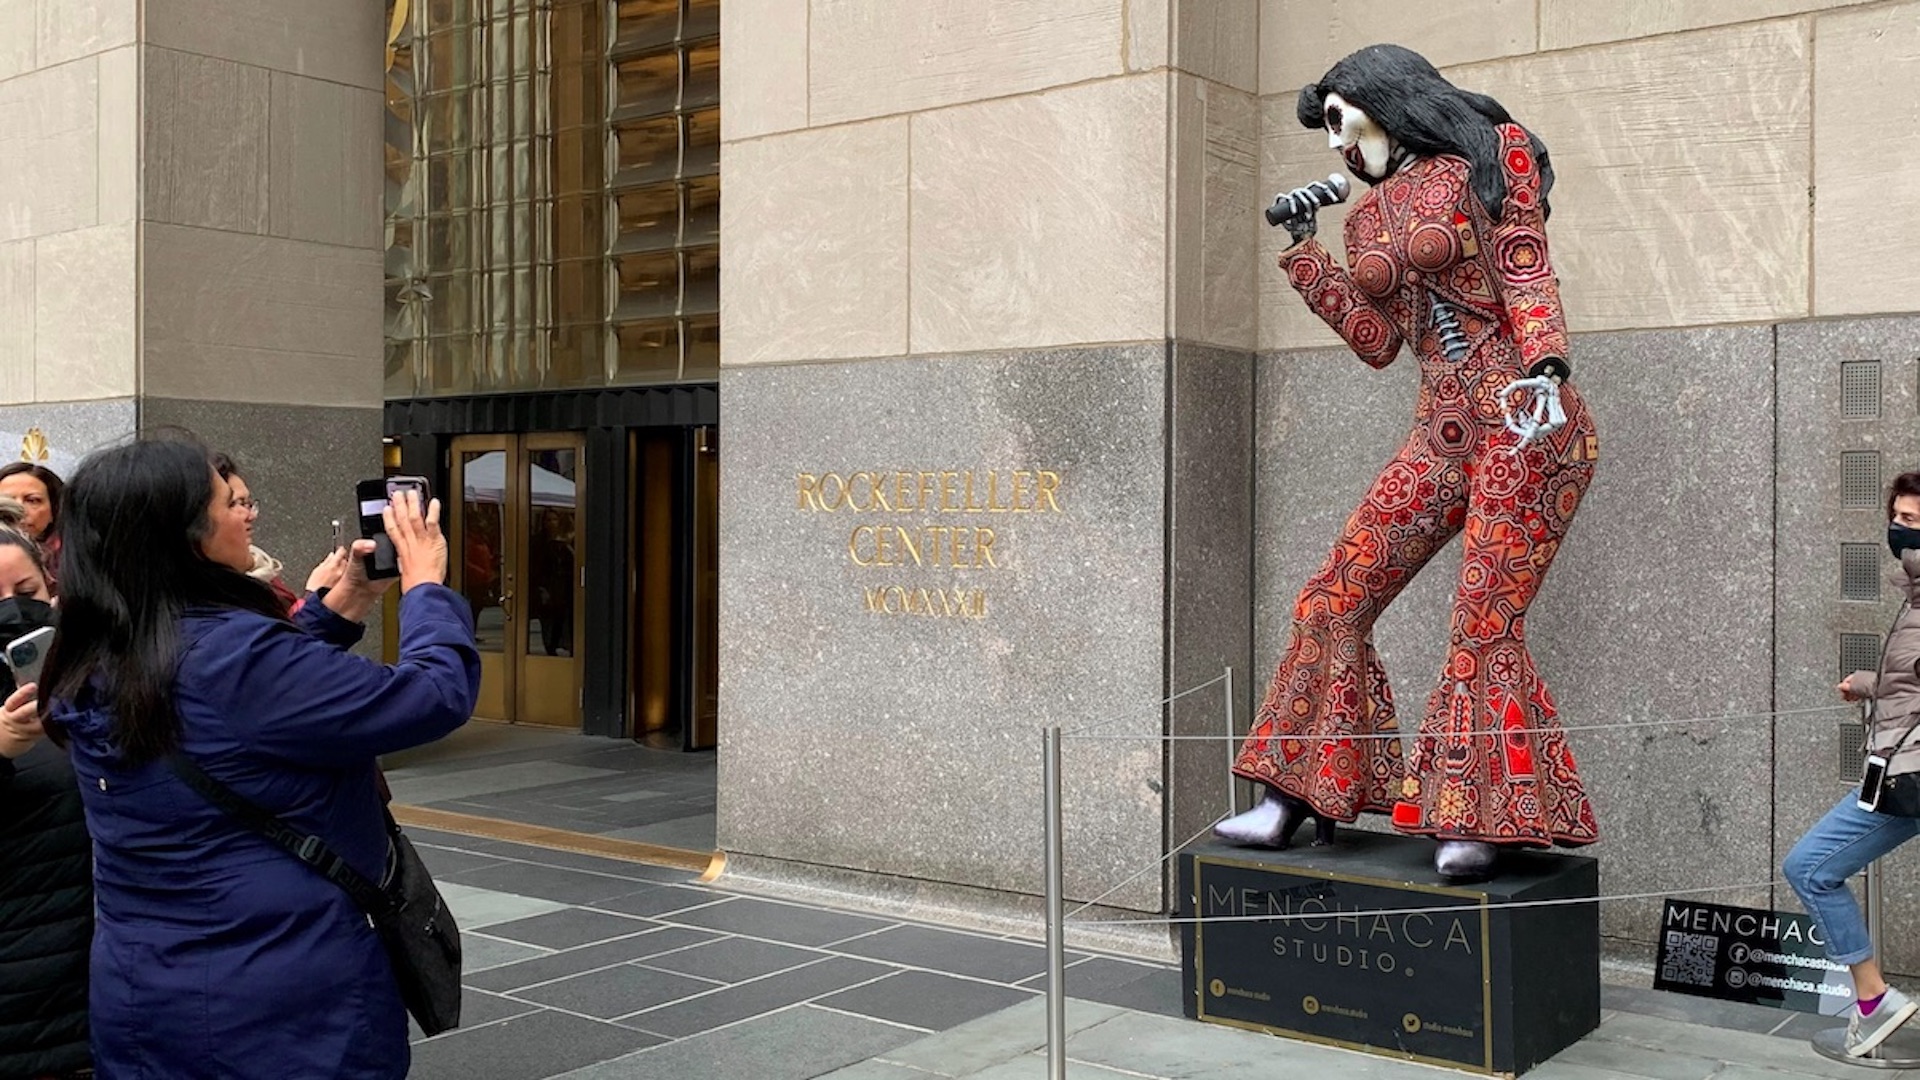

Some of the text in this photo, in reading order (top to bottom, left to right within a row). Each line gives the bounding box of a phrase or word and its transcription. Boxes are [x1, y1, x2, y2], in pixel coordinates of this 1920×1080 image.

[798, 470, 1061, 513] ROCKEFELLER
[850, 525, 997, 568] CENTER
[1208, 883, 1472, 955] MENCHACA
[1666, 905, 1825, 946] MENCHAC
[1272, 936, 1396, 973] STUDIO
[1748, 972, 1852, 998] @menchaca.studio
